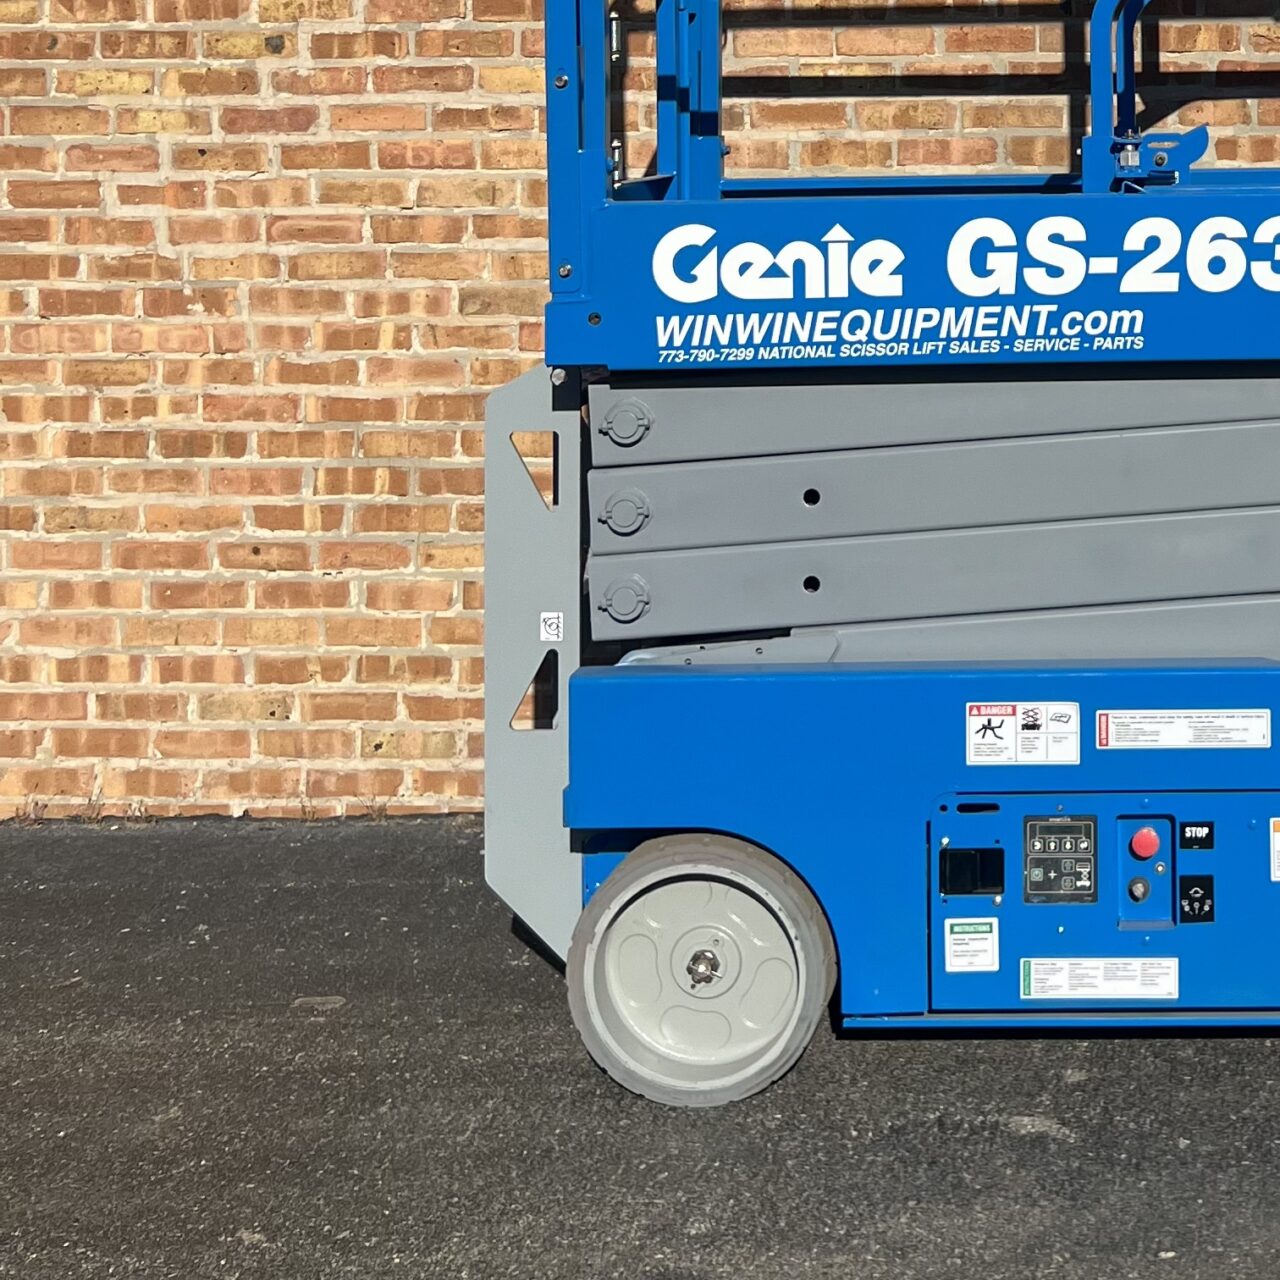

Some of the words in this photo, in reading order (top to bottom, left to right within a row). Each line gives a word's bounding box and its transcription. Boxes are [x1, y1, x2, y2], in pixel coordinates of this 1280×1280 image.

[652, 223, 905, 304] Genie
[656, 304, 1144, 348] WINWINEQUIPMENT.com
[659, 347, 755, 363] 773-790-7299
[757, 344, 836, 360] NATIONAL
[839, 341, 910, 358] SCISSOR
[912, 341, 947, 355] LIFT
[948, 339, 1001, 354] SALES
[1013, 337, 1081, 352] SERVICE
[1093, 335, 1144, 350] PARTS
[980, 705, 1014, 715] DANGER
[1185, 826, 1209, 838] STOP
